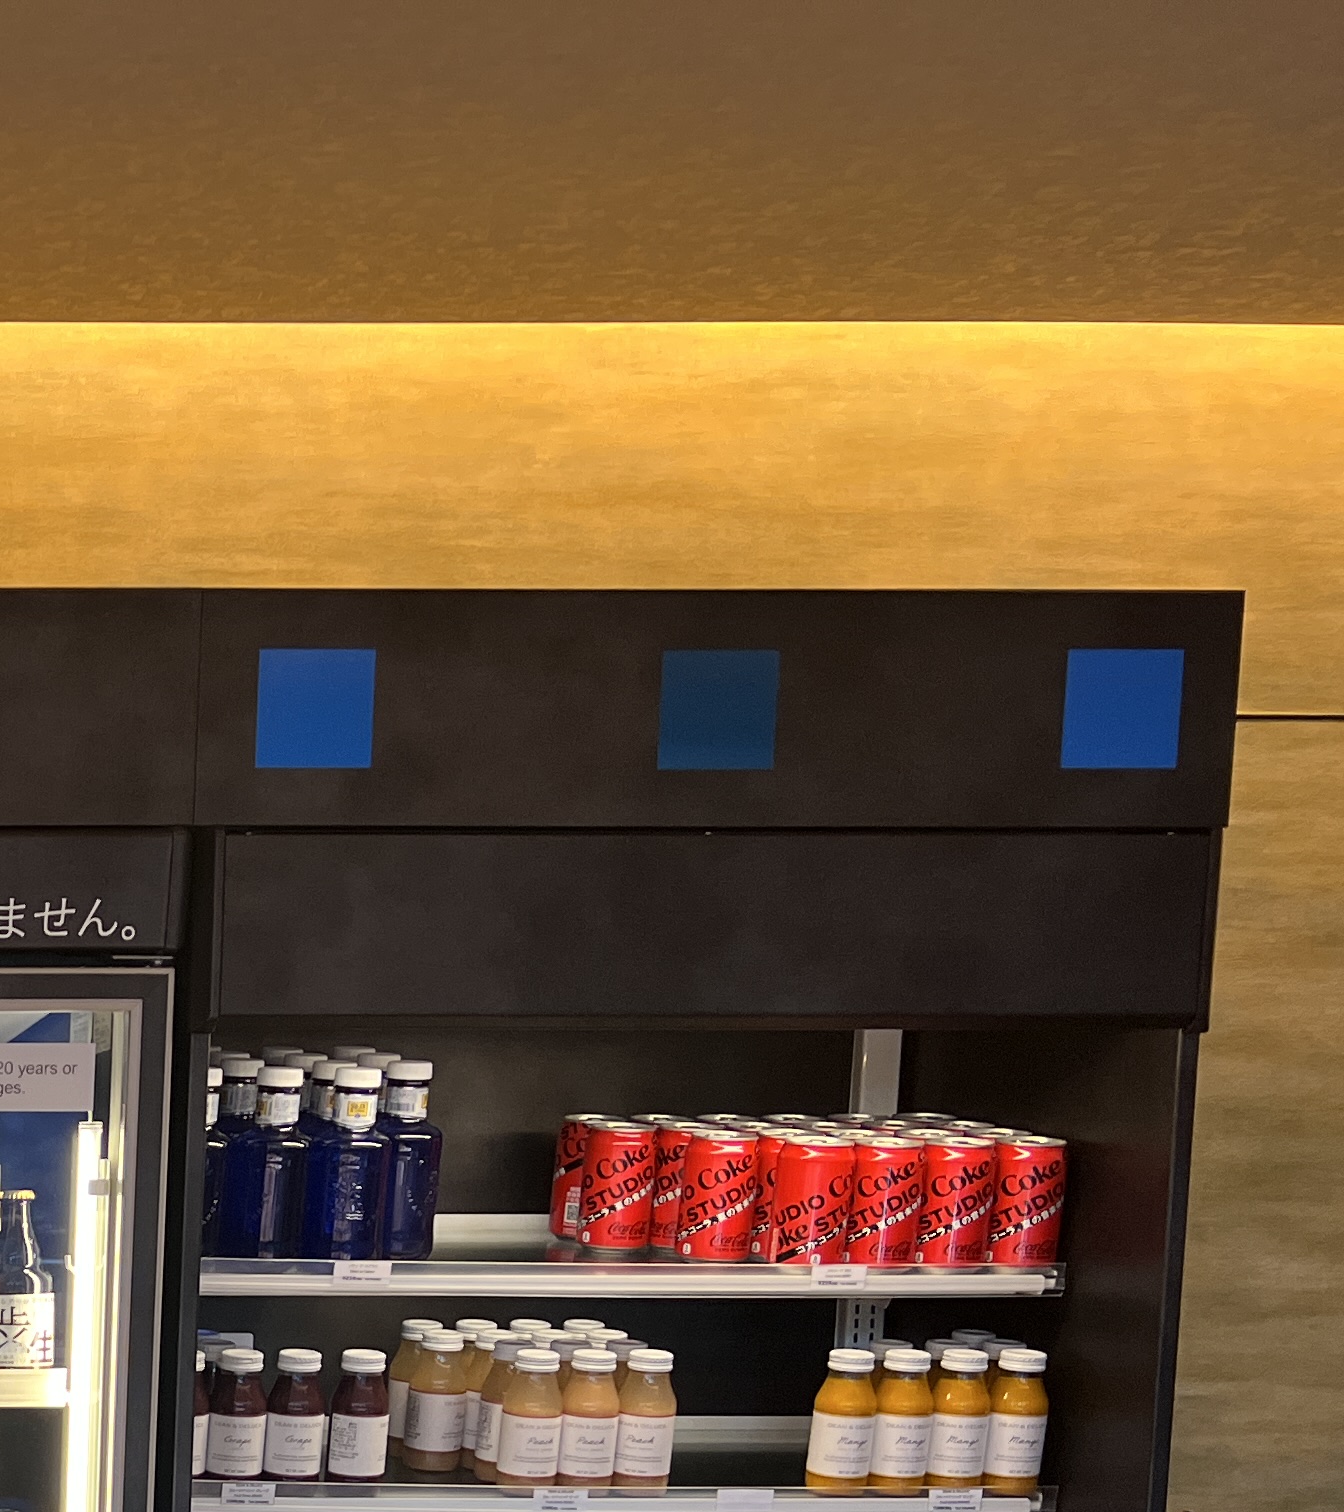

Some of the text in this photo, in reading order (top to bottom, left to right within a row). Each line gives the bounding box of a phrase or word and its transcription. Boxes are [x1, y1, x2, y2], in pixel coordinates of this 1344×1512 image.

[18, 1063, 58, 1079] years
[63, 1064, 77, 1075] or
[596, 1144, 650, 1180] Coke
[698, 1153, 752, 1191] Coke
[857, 1160, 916, 1198] Coke
[931, 1157, 990, 1198] Coke
[1000, 1158, 1061, 1198] Coke
[586, 1165, 654, 1211] STUDIO
[687, 1174, 757, 1221] STUDIO
[848, 1182, 921, 1230] STUDIO
[919, 1182, 994, 1230] STUDIO
[990, 1182, 1062, 1230] STUDIO
[224, 1435, 252, 1448] Grape
[285, 1435, 312, 1448] Grape
[527, 1436, 554, 1446] Peach
[577, 1436, 605, 1446] Peach
[626, 1434, 654, 1445] Peach
